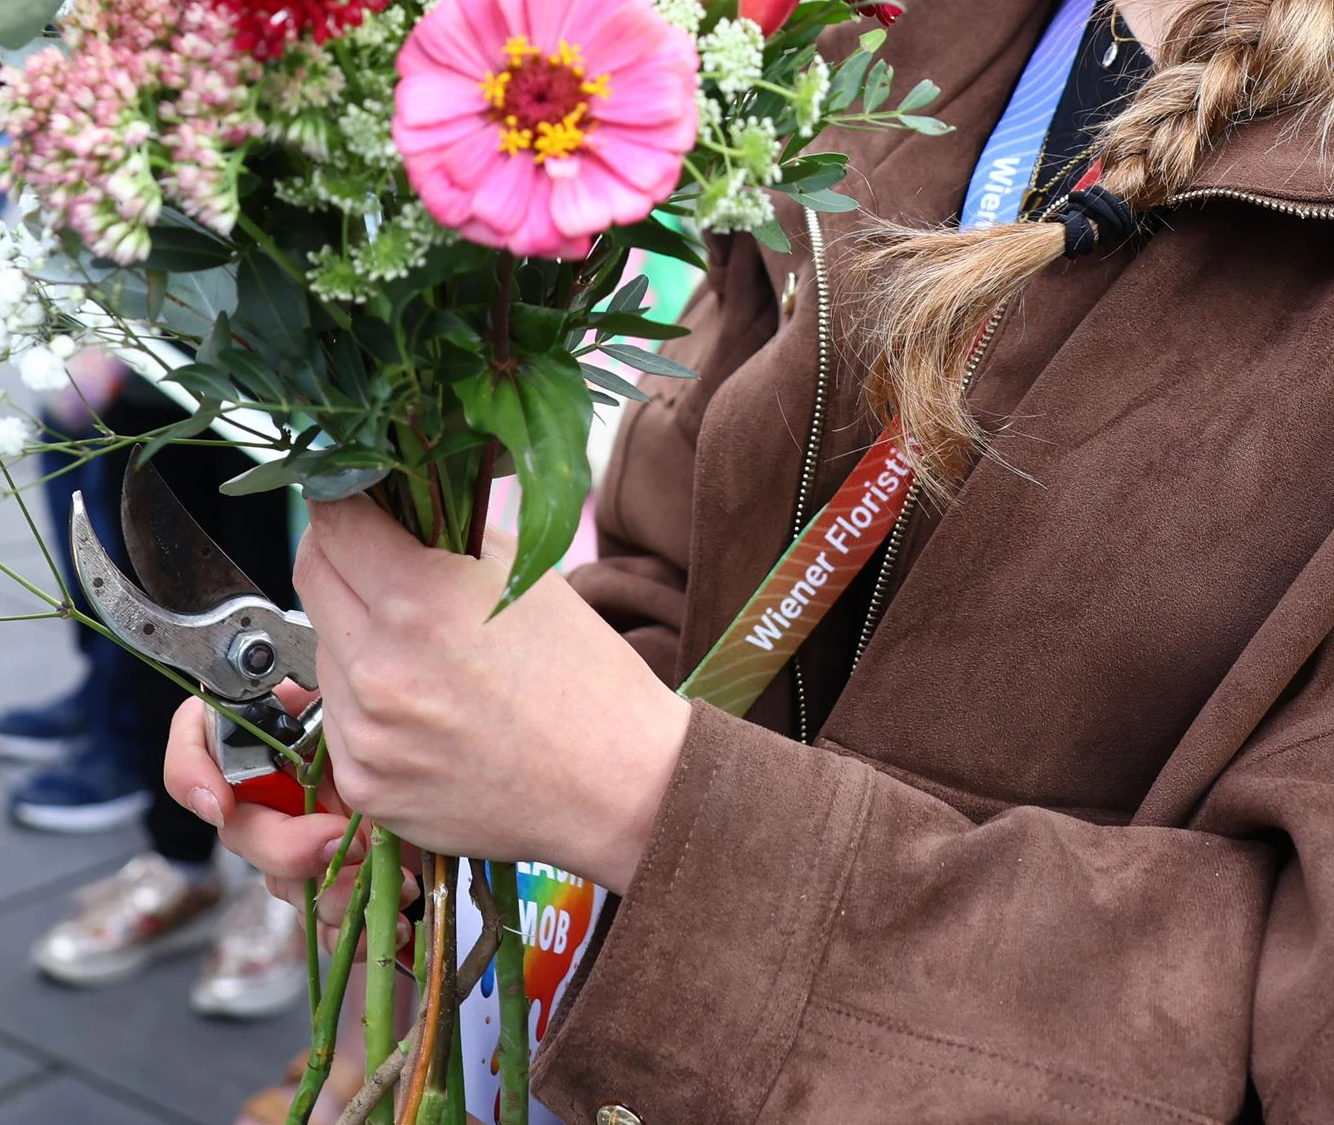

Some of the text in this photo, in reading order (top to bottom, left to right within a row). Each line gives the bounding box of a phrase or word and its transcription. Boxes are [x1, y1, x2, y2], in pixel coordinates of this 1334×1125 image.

[975, 157, 1020, 230] Wien
[745, 443, 916, 651] Wiener Floristi
[518, 898, 571, 955] MOB
